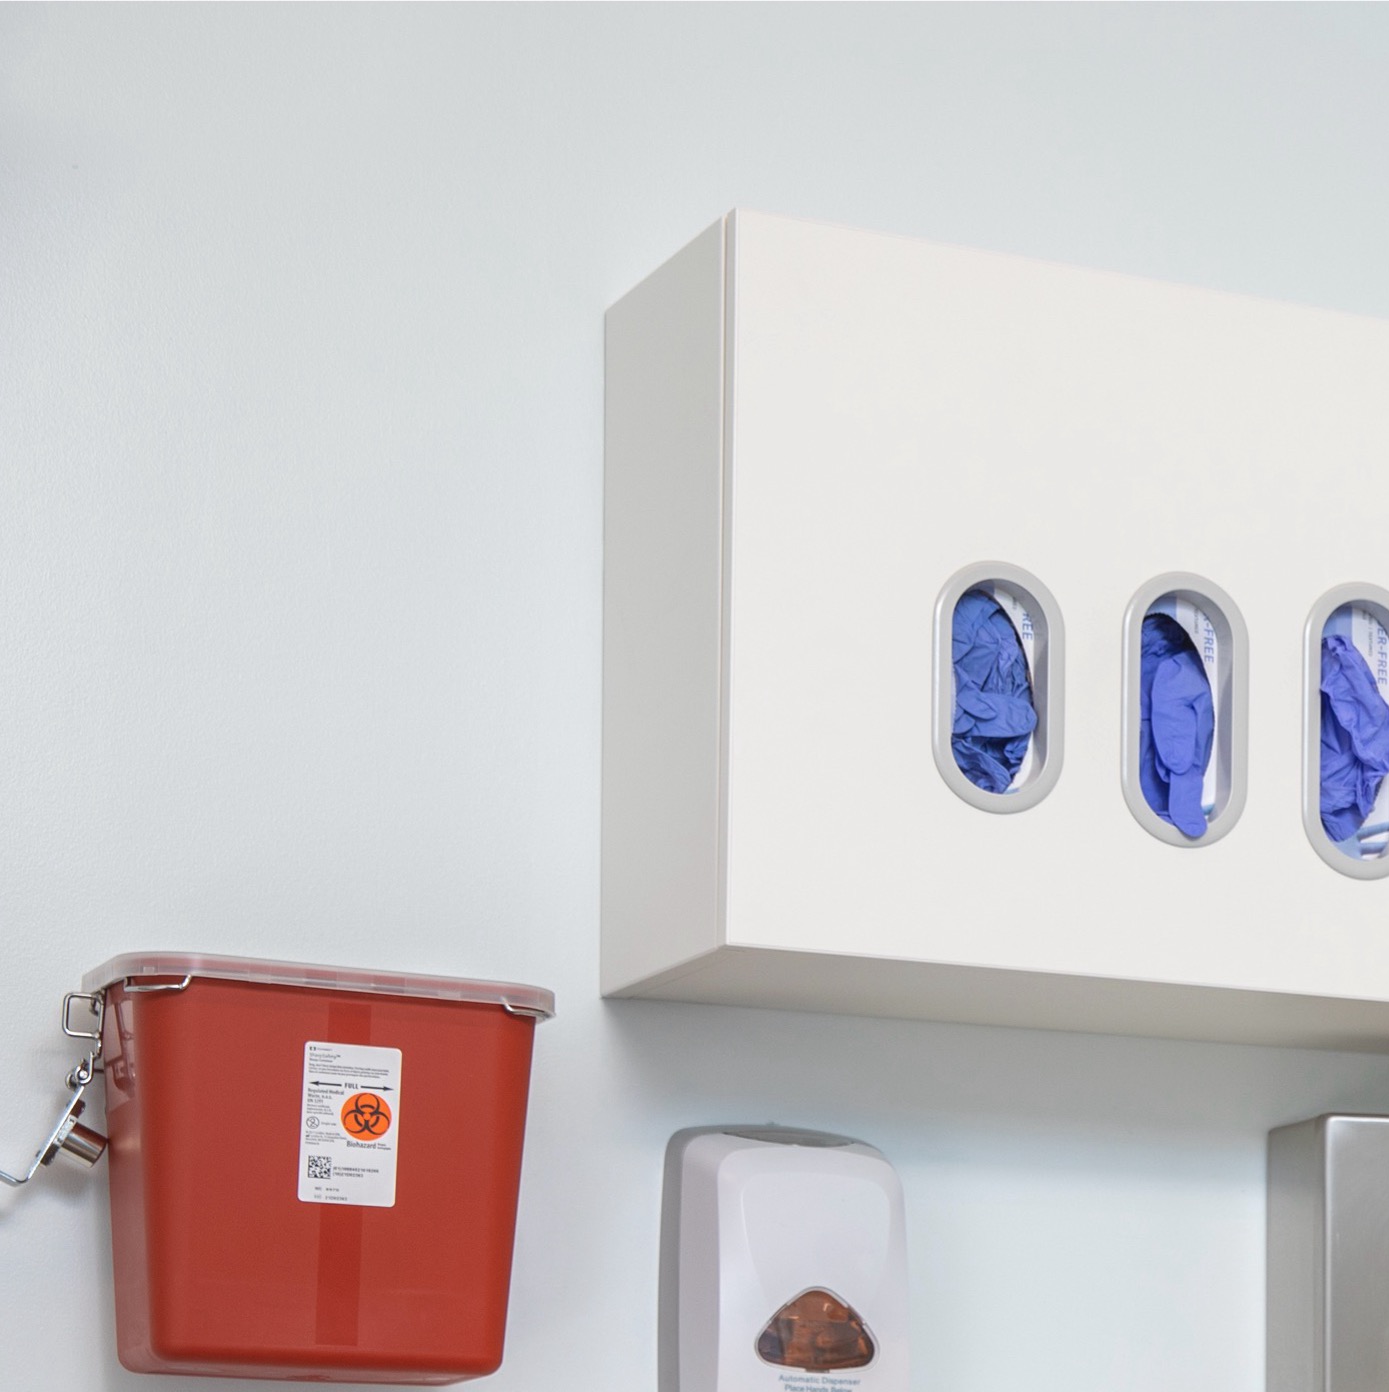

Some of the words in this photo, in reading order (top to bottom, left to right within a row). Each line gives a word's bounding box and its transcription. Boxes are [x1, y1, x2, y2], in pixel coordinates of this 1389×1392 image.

[344, 1082, 359, 1090] FULL
[346, 1141, 376, 1149] Biohazard
[779, 1375, 820, 1383] Automatic
[821, 1377, 861, 1385] Dispenser
[784, 1384, 804, 1392] Place
